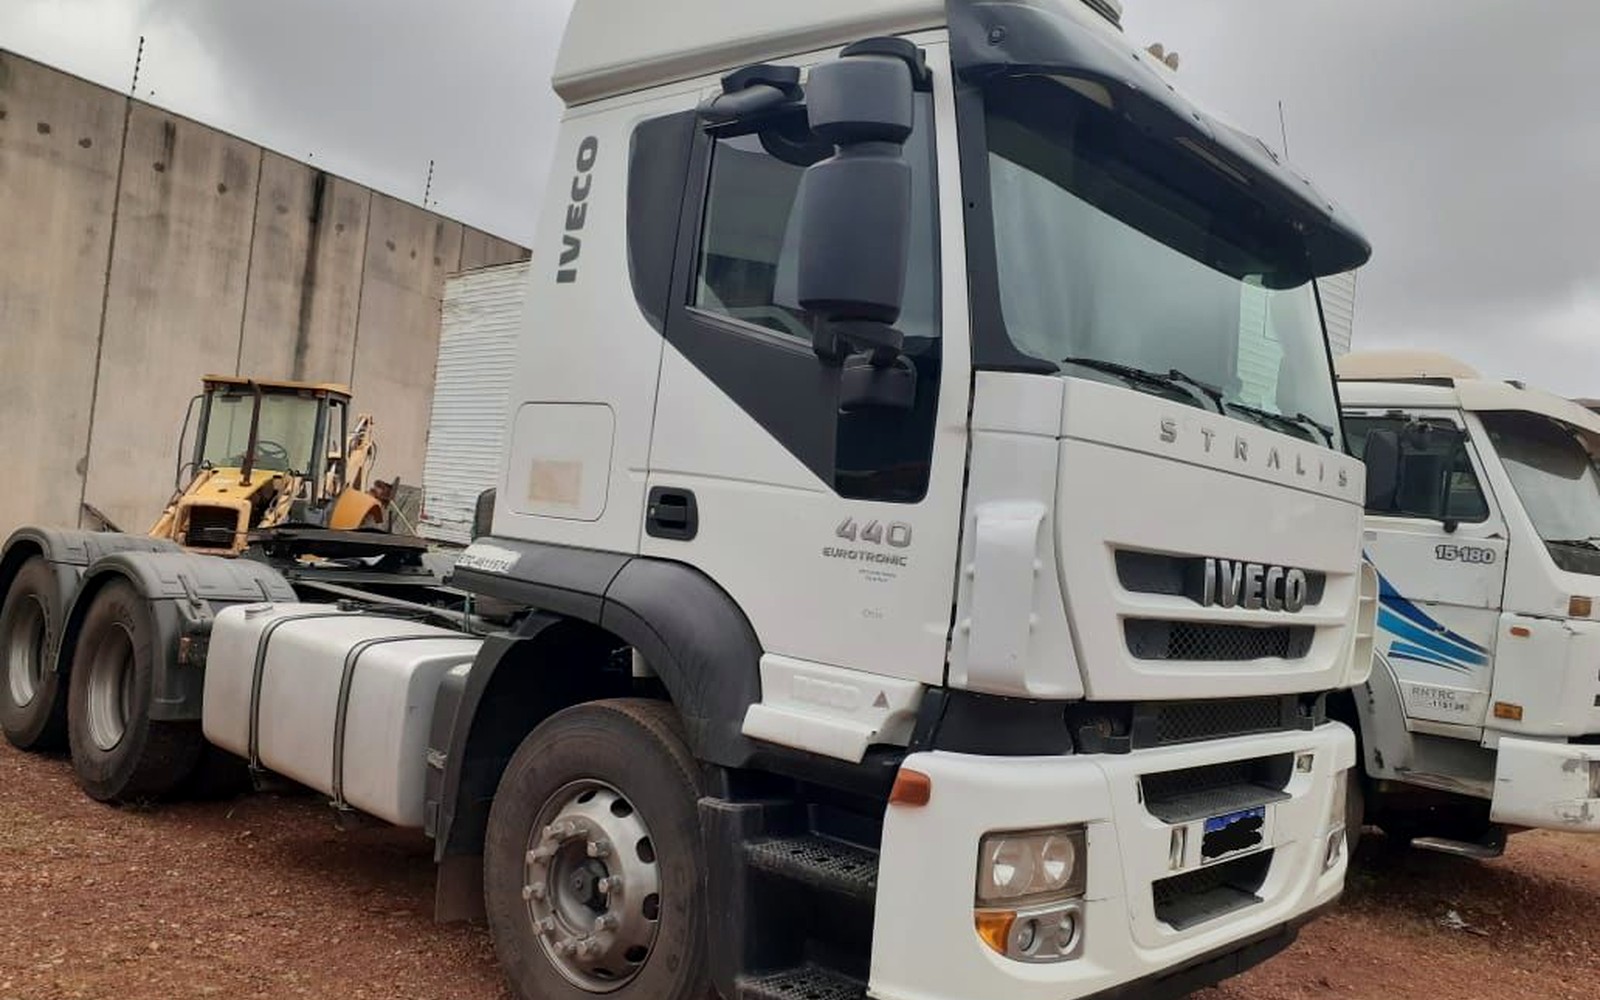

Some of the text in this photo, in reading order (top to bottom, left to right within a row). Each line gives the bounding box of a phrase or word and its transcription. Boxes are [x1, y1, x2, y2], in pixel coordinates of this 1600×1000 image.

[556, 135, 599, 284] IVECO
[1160, 418, 1348, 487] STRALIS
[835, 516, 913, 548] 440
[822, 546, 908, 567] EUROTRONIC
[1435, 544, 1496, 565] 15-180
[1203, 557, 1307, 613] IVECO
